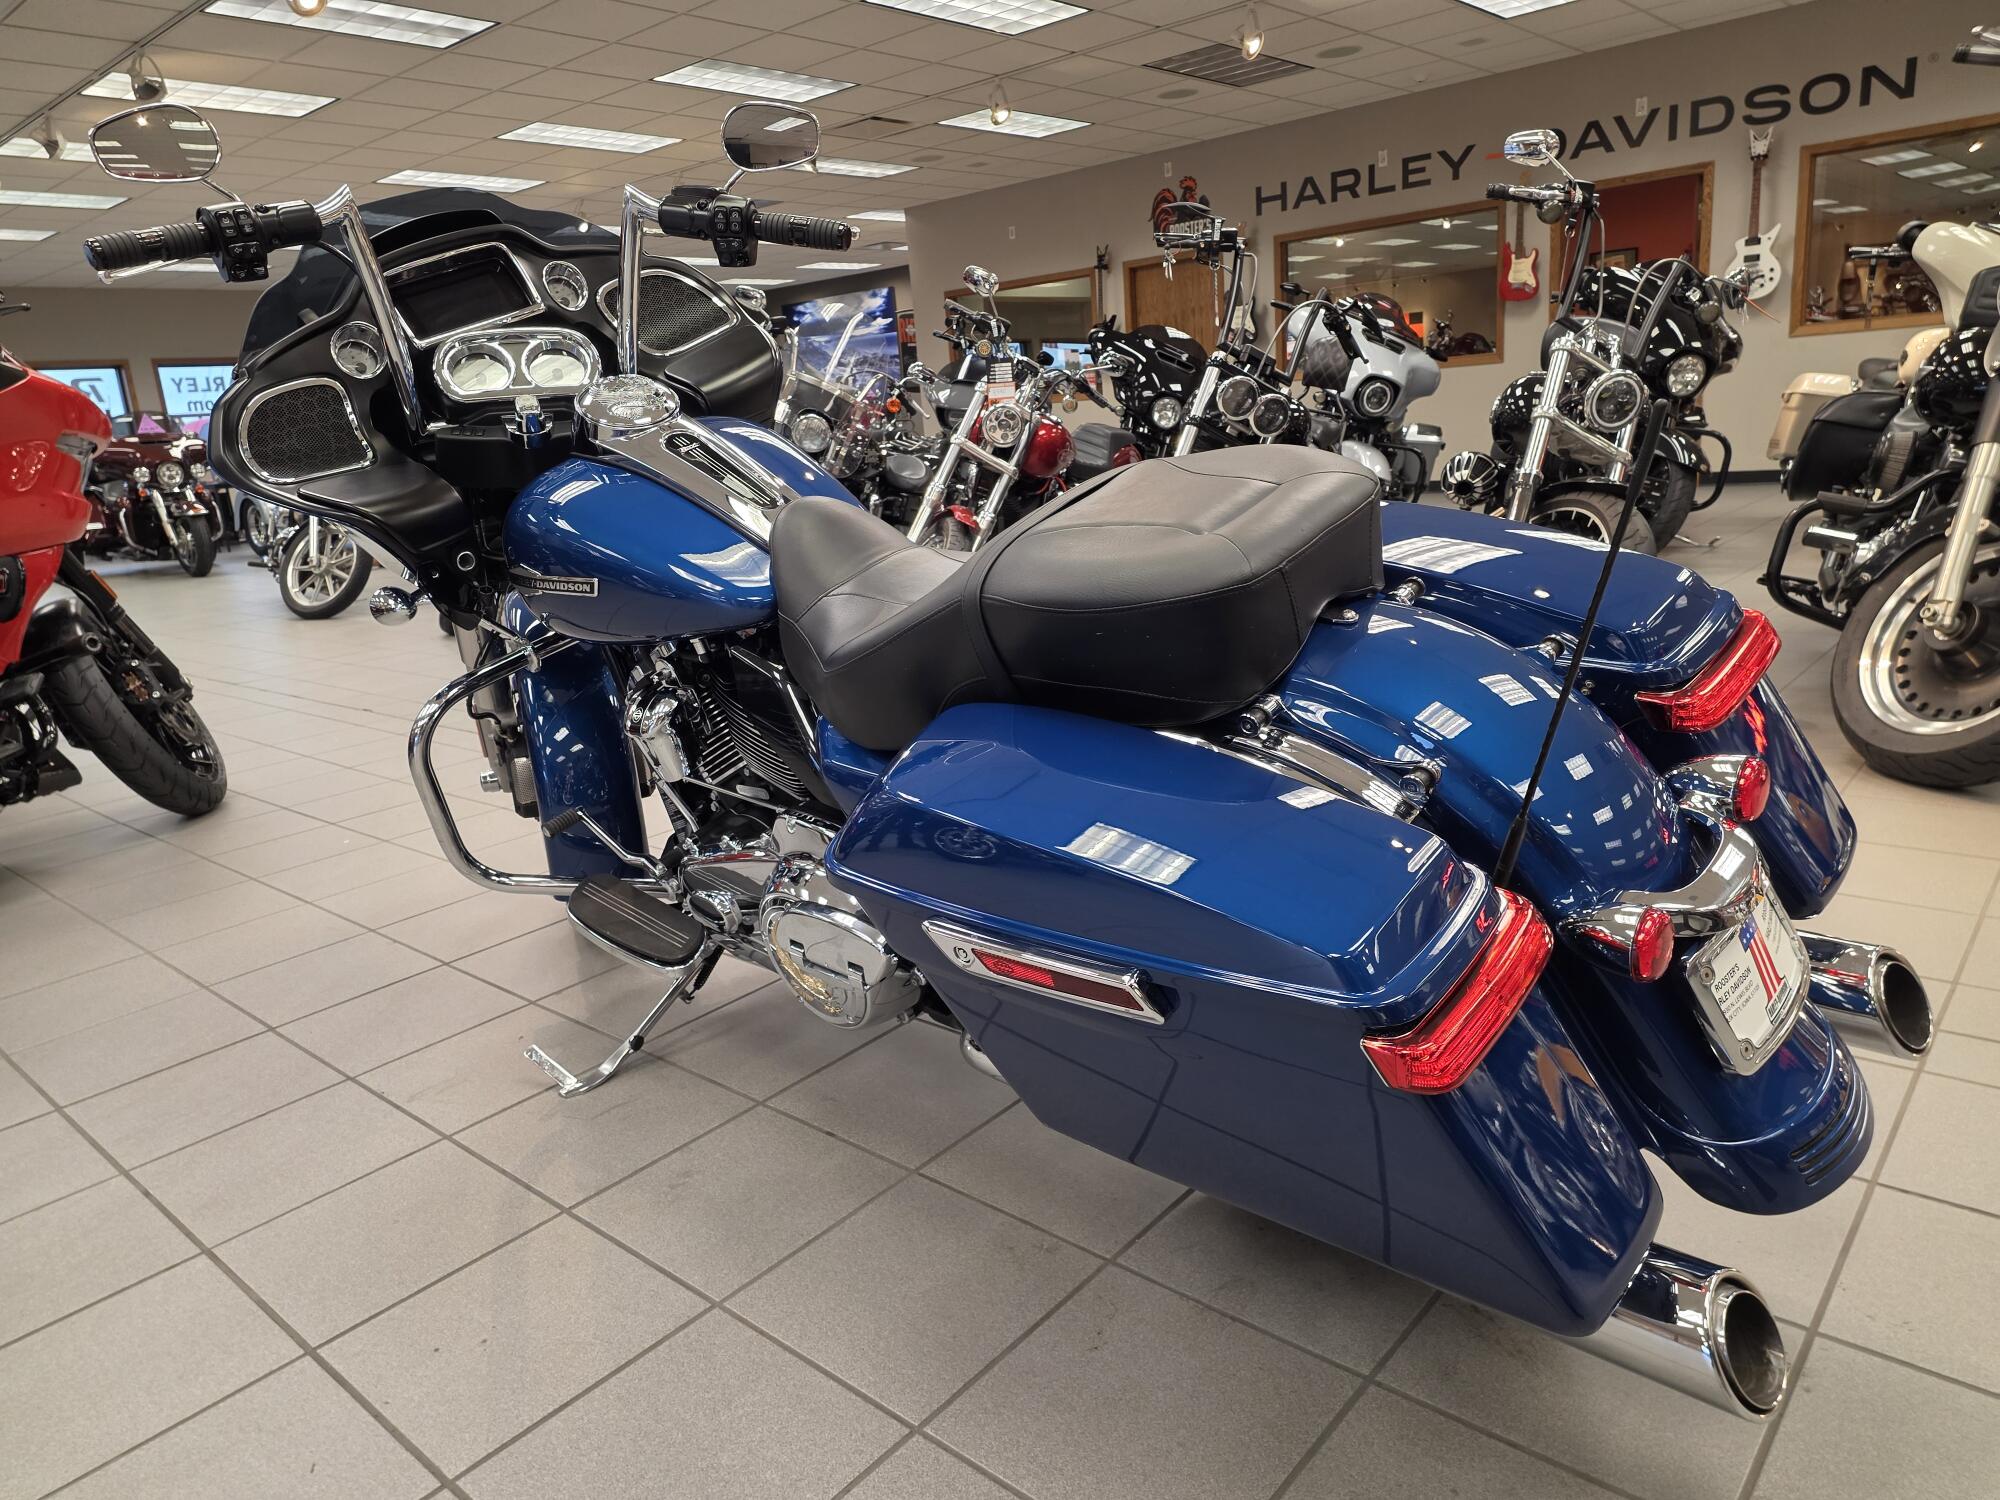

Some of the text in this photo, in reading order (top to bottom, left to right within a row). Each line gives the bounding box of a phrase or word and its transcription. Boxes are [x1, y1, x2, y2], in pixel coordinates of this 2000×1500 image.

[1255, 144, 1477, 216] HARLEY
[1714, 963, 1740, 993] ROOSTER'S
[1718, 989, 1731, 1006] RLEY
[1730, 965, 1752, 994] DAVIDSON
